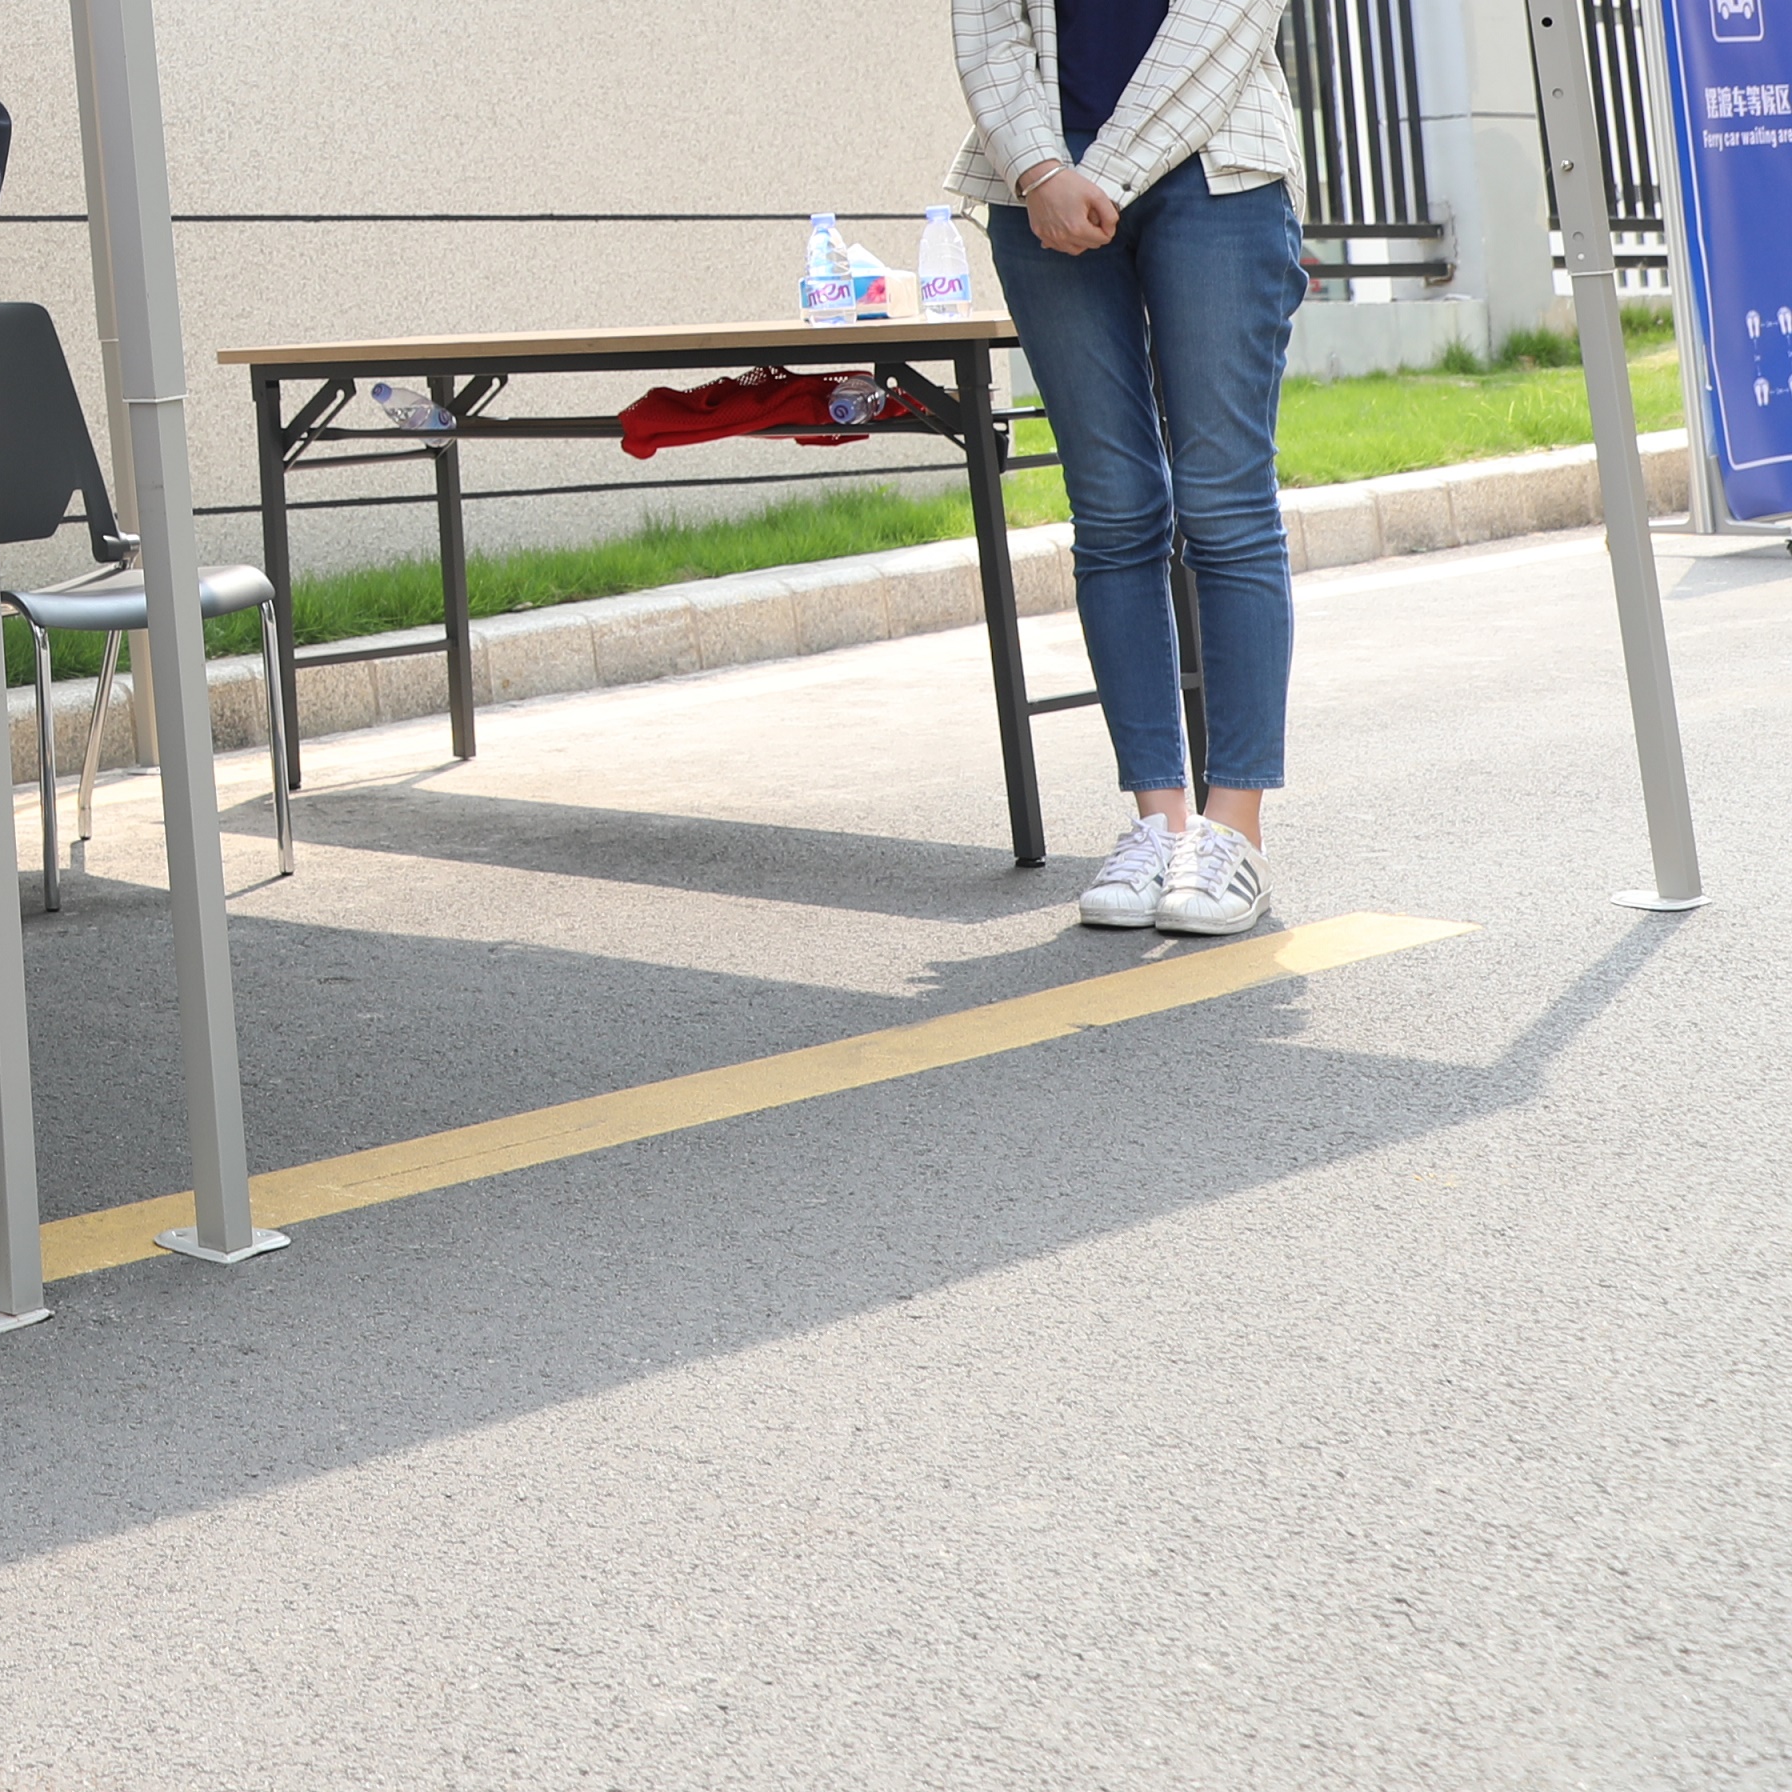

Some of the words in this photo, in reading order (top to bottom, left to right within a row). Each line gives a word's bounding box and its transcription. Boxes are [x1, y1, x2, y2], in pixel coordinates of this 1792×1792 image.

[1702, 129, 1723, 152] Ferry
[1724, 131, 1740, 147] car
[1741, 125, 1777, 149] waiting
